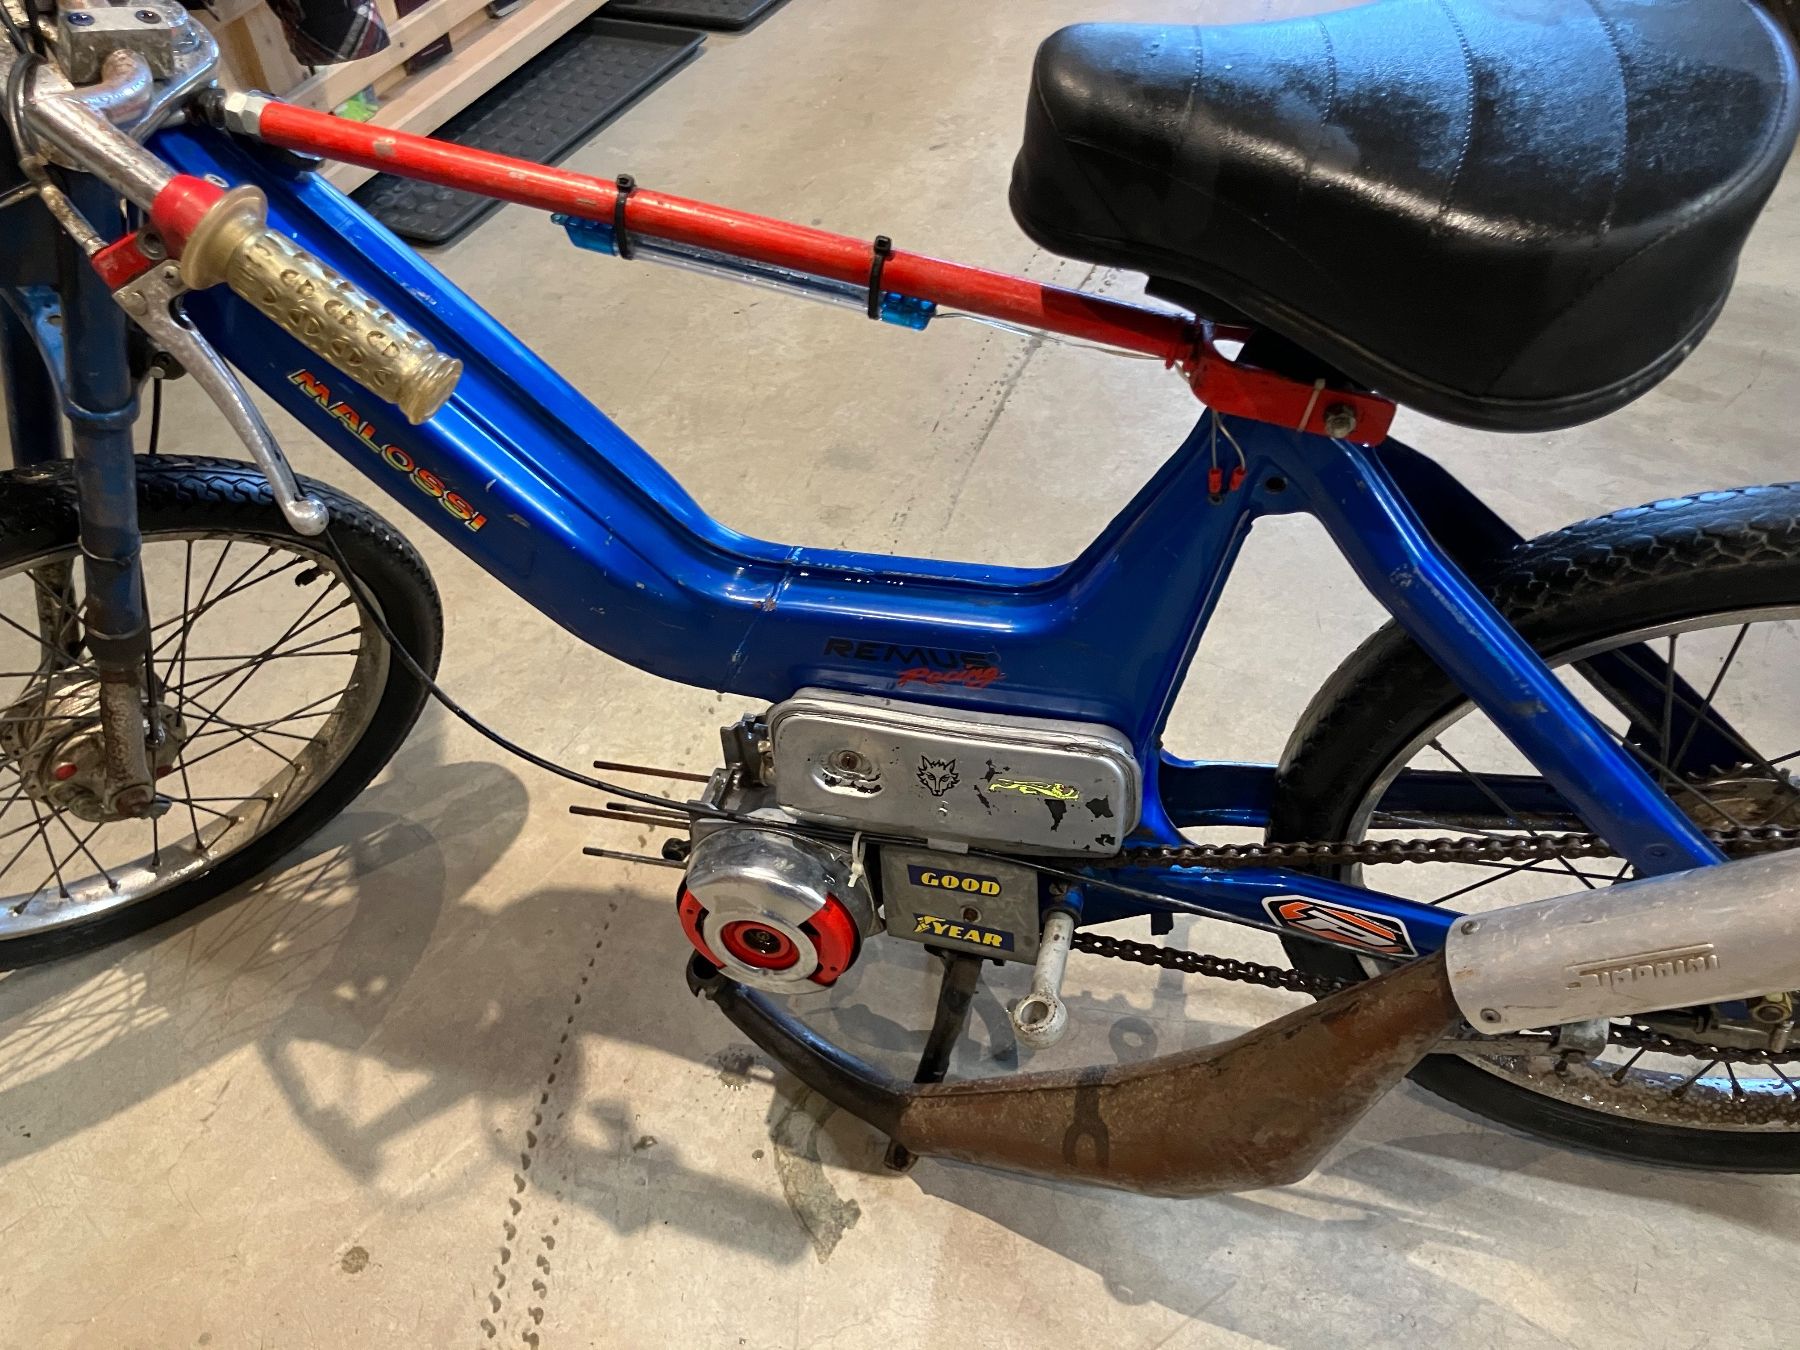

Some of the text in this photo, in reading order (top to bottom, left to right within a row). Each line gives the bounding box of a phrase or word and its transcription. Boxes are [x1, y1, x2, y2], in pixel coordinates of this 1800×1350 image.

[287, 369, 488, 532] MALOSSI
[824, 637, 993, 669] REMUS
[897, 663, 1001, 690] Racing
[921, 872, 1001, 895] GOOD
[931, 921, 1003, 947] YEAR
